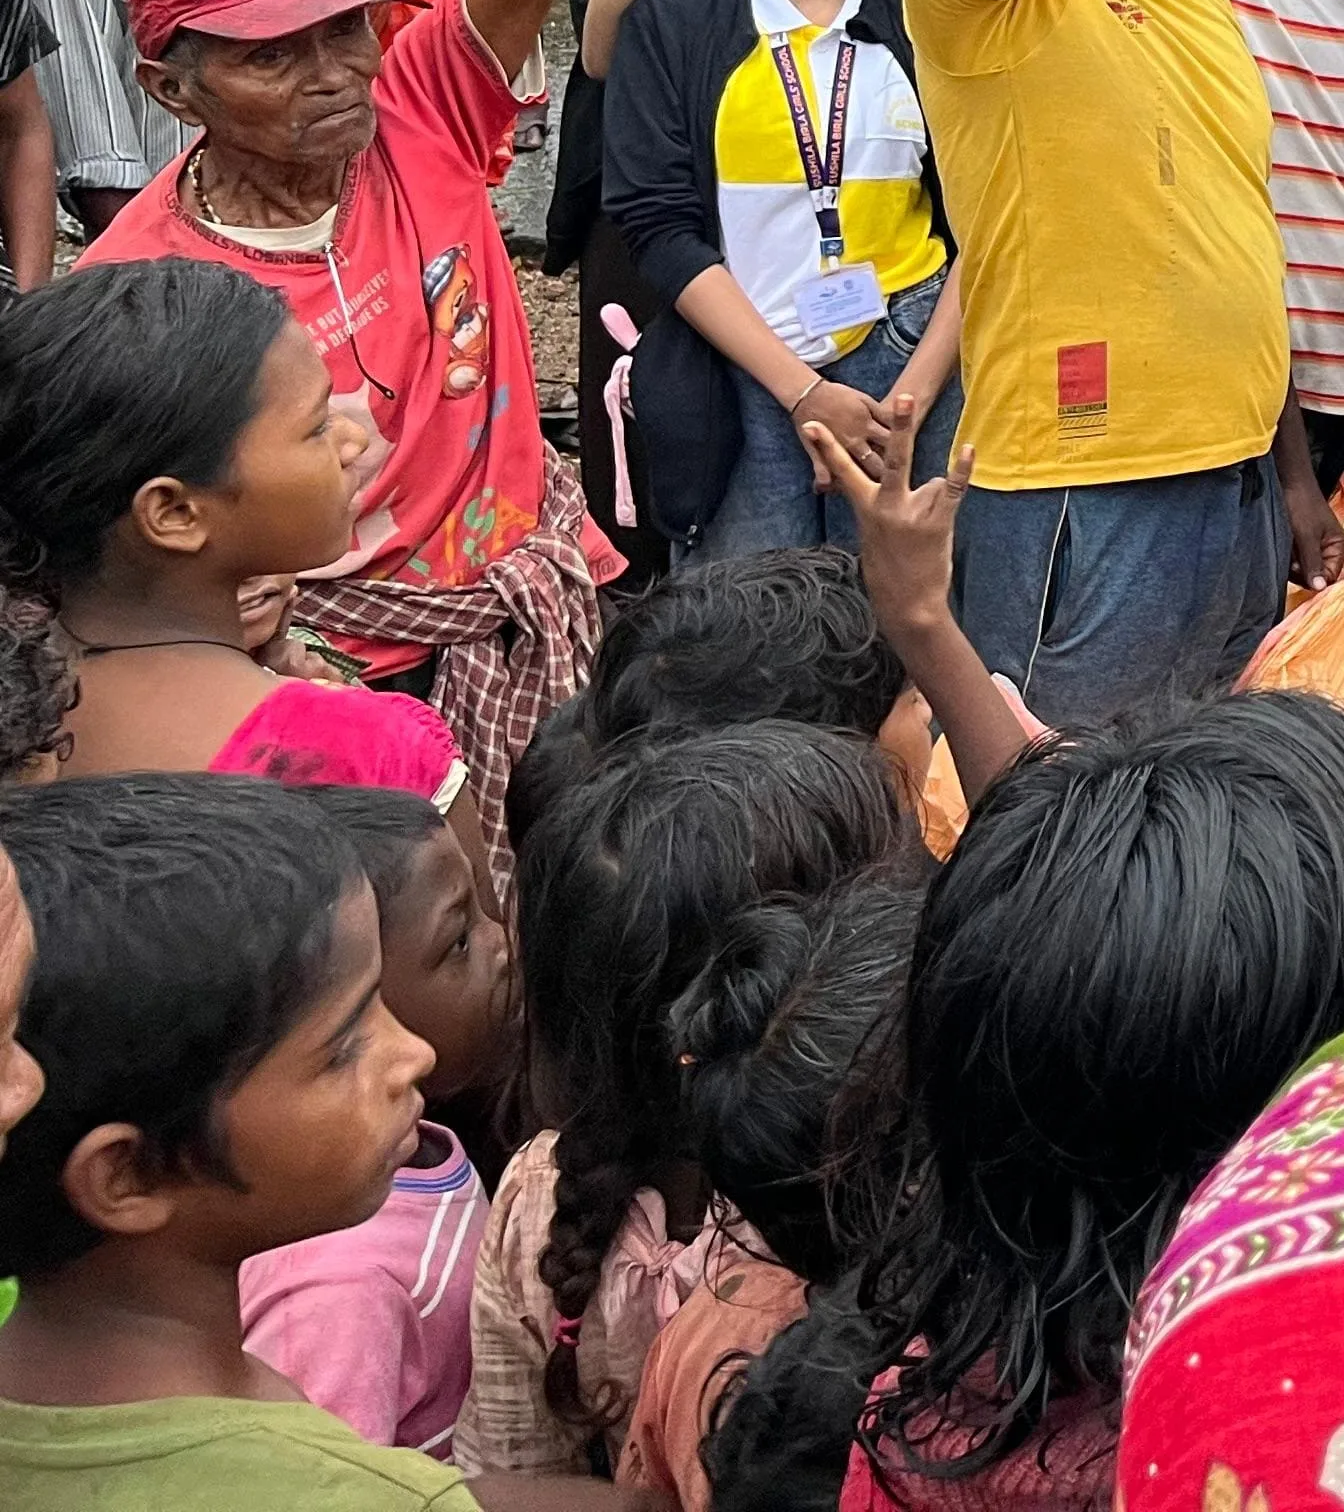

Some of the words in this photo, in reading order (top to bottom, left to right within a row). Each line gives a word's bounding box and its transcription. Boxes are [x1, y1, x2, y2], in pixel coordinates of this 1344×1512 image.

[777, 46, 797, 85] SCHOOL
[839, 46, 853, 81] SCHOOL
[797, 113, 813, 144] BIRLA
[831, 111, 844, 141] BIRLA
[805, 145, 823, 188] SUSHILA
[828, 143, 841, 185] SUSHILA
